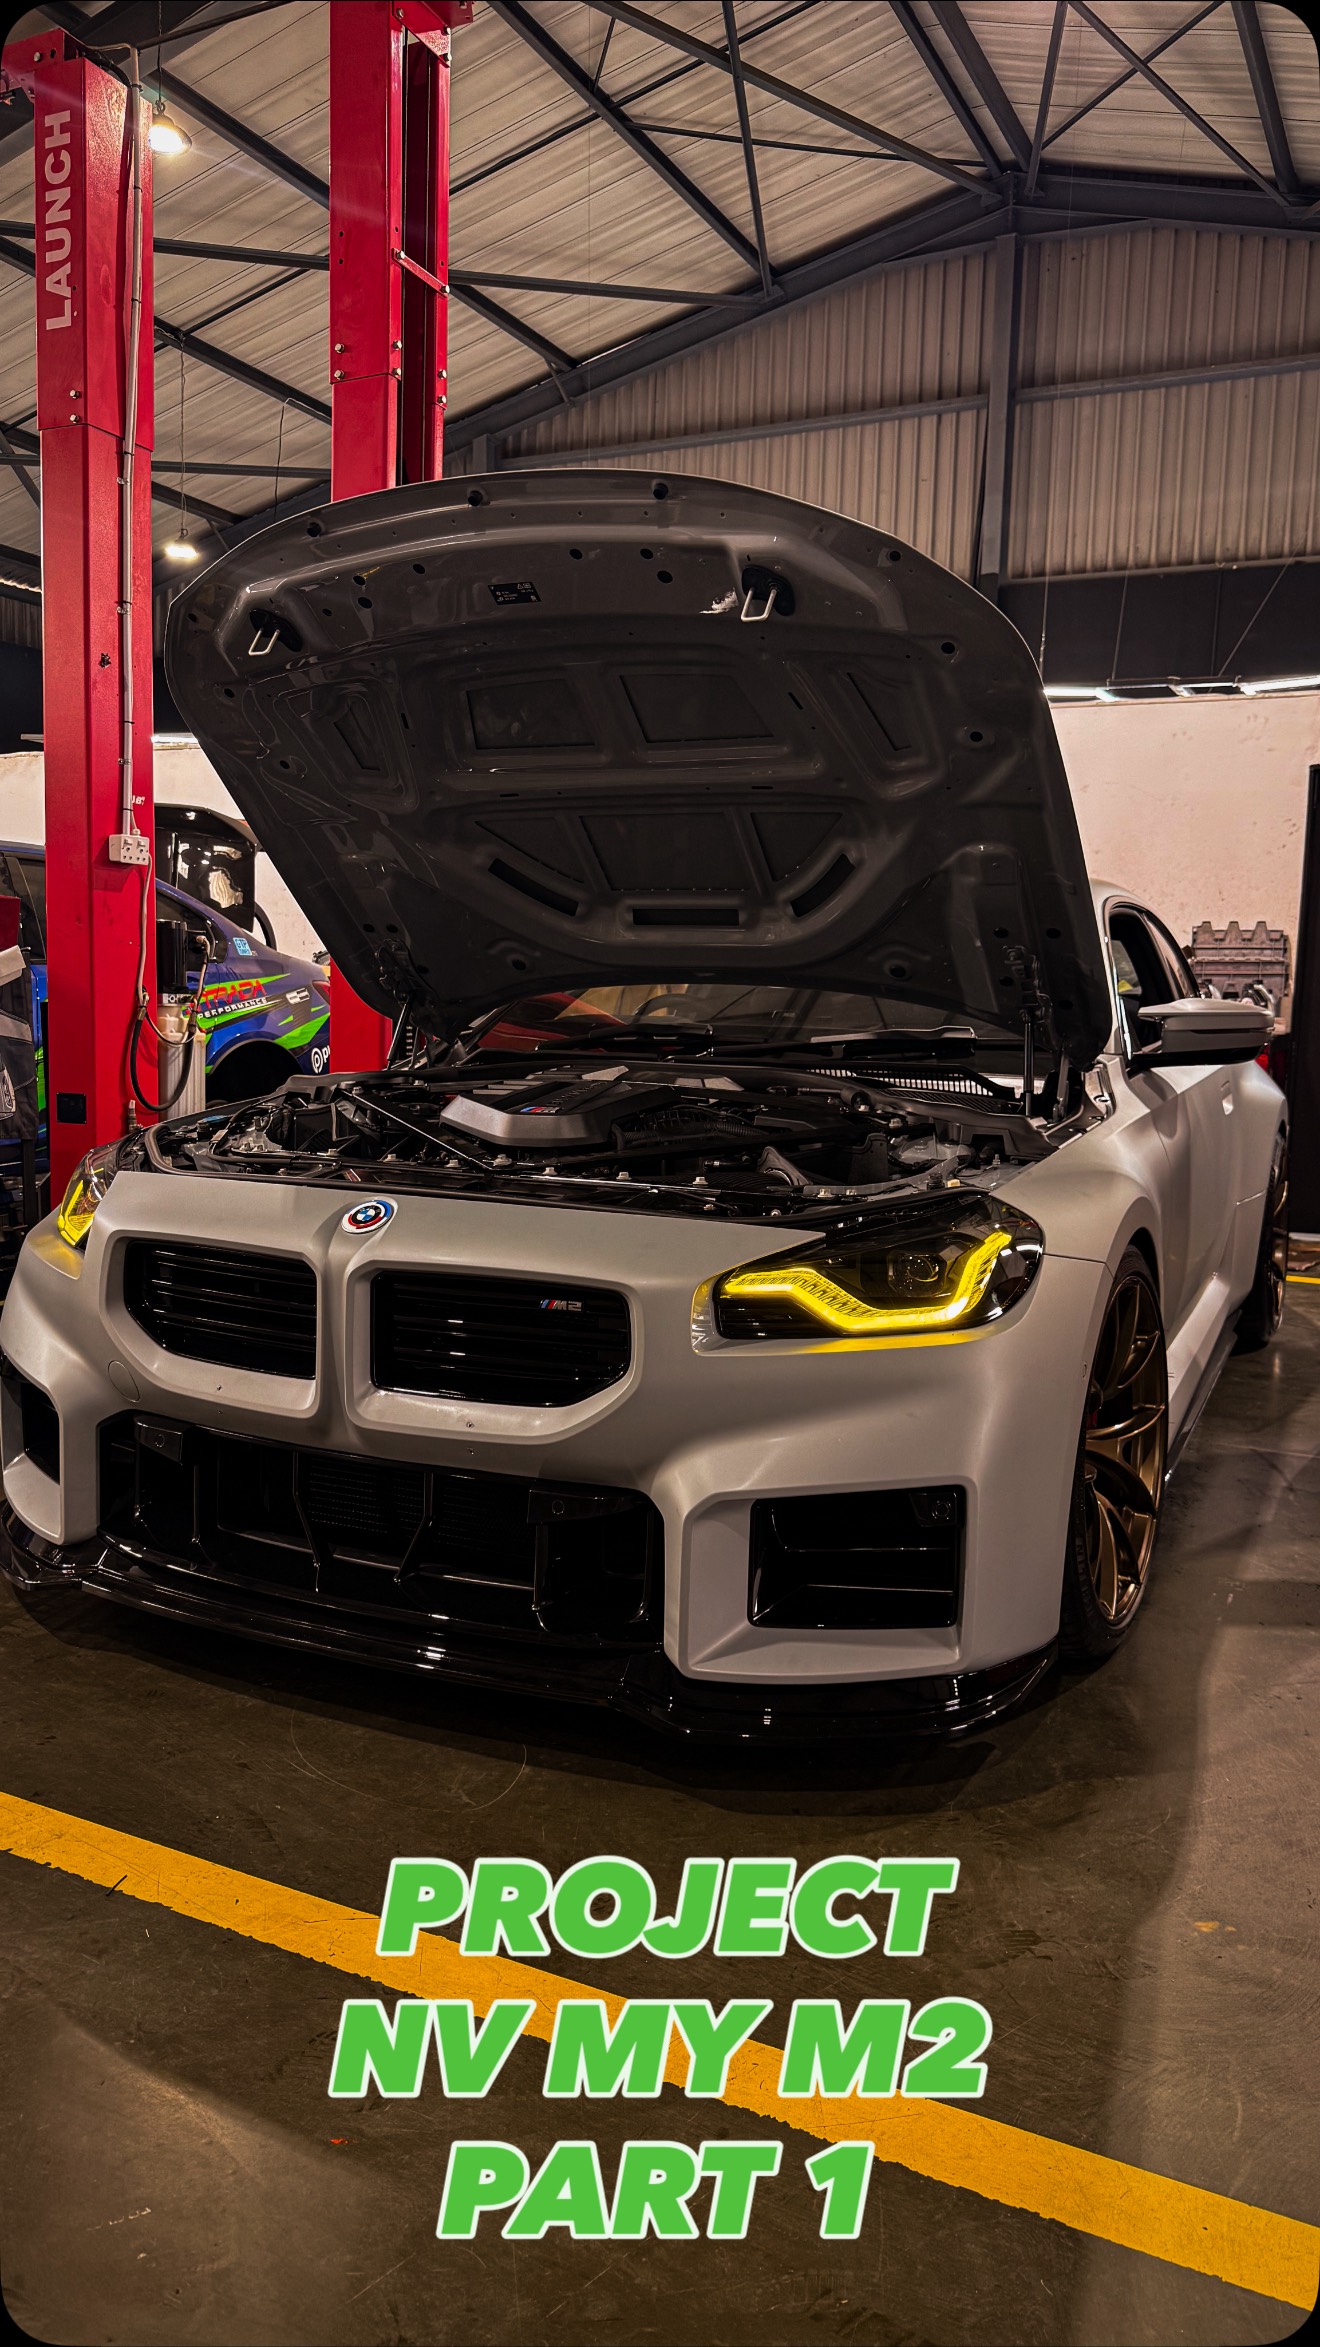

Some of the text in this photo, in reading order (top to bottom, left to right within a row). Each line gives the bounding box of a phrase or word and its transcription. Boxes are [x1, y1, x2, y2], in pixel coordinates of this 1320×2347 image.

[45, 110, 72, 330] LAUNCH
[190, 979, 267, 1014] TRADA
[197, 997, 268, 1020] PERFORMANCE
